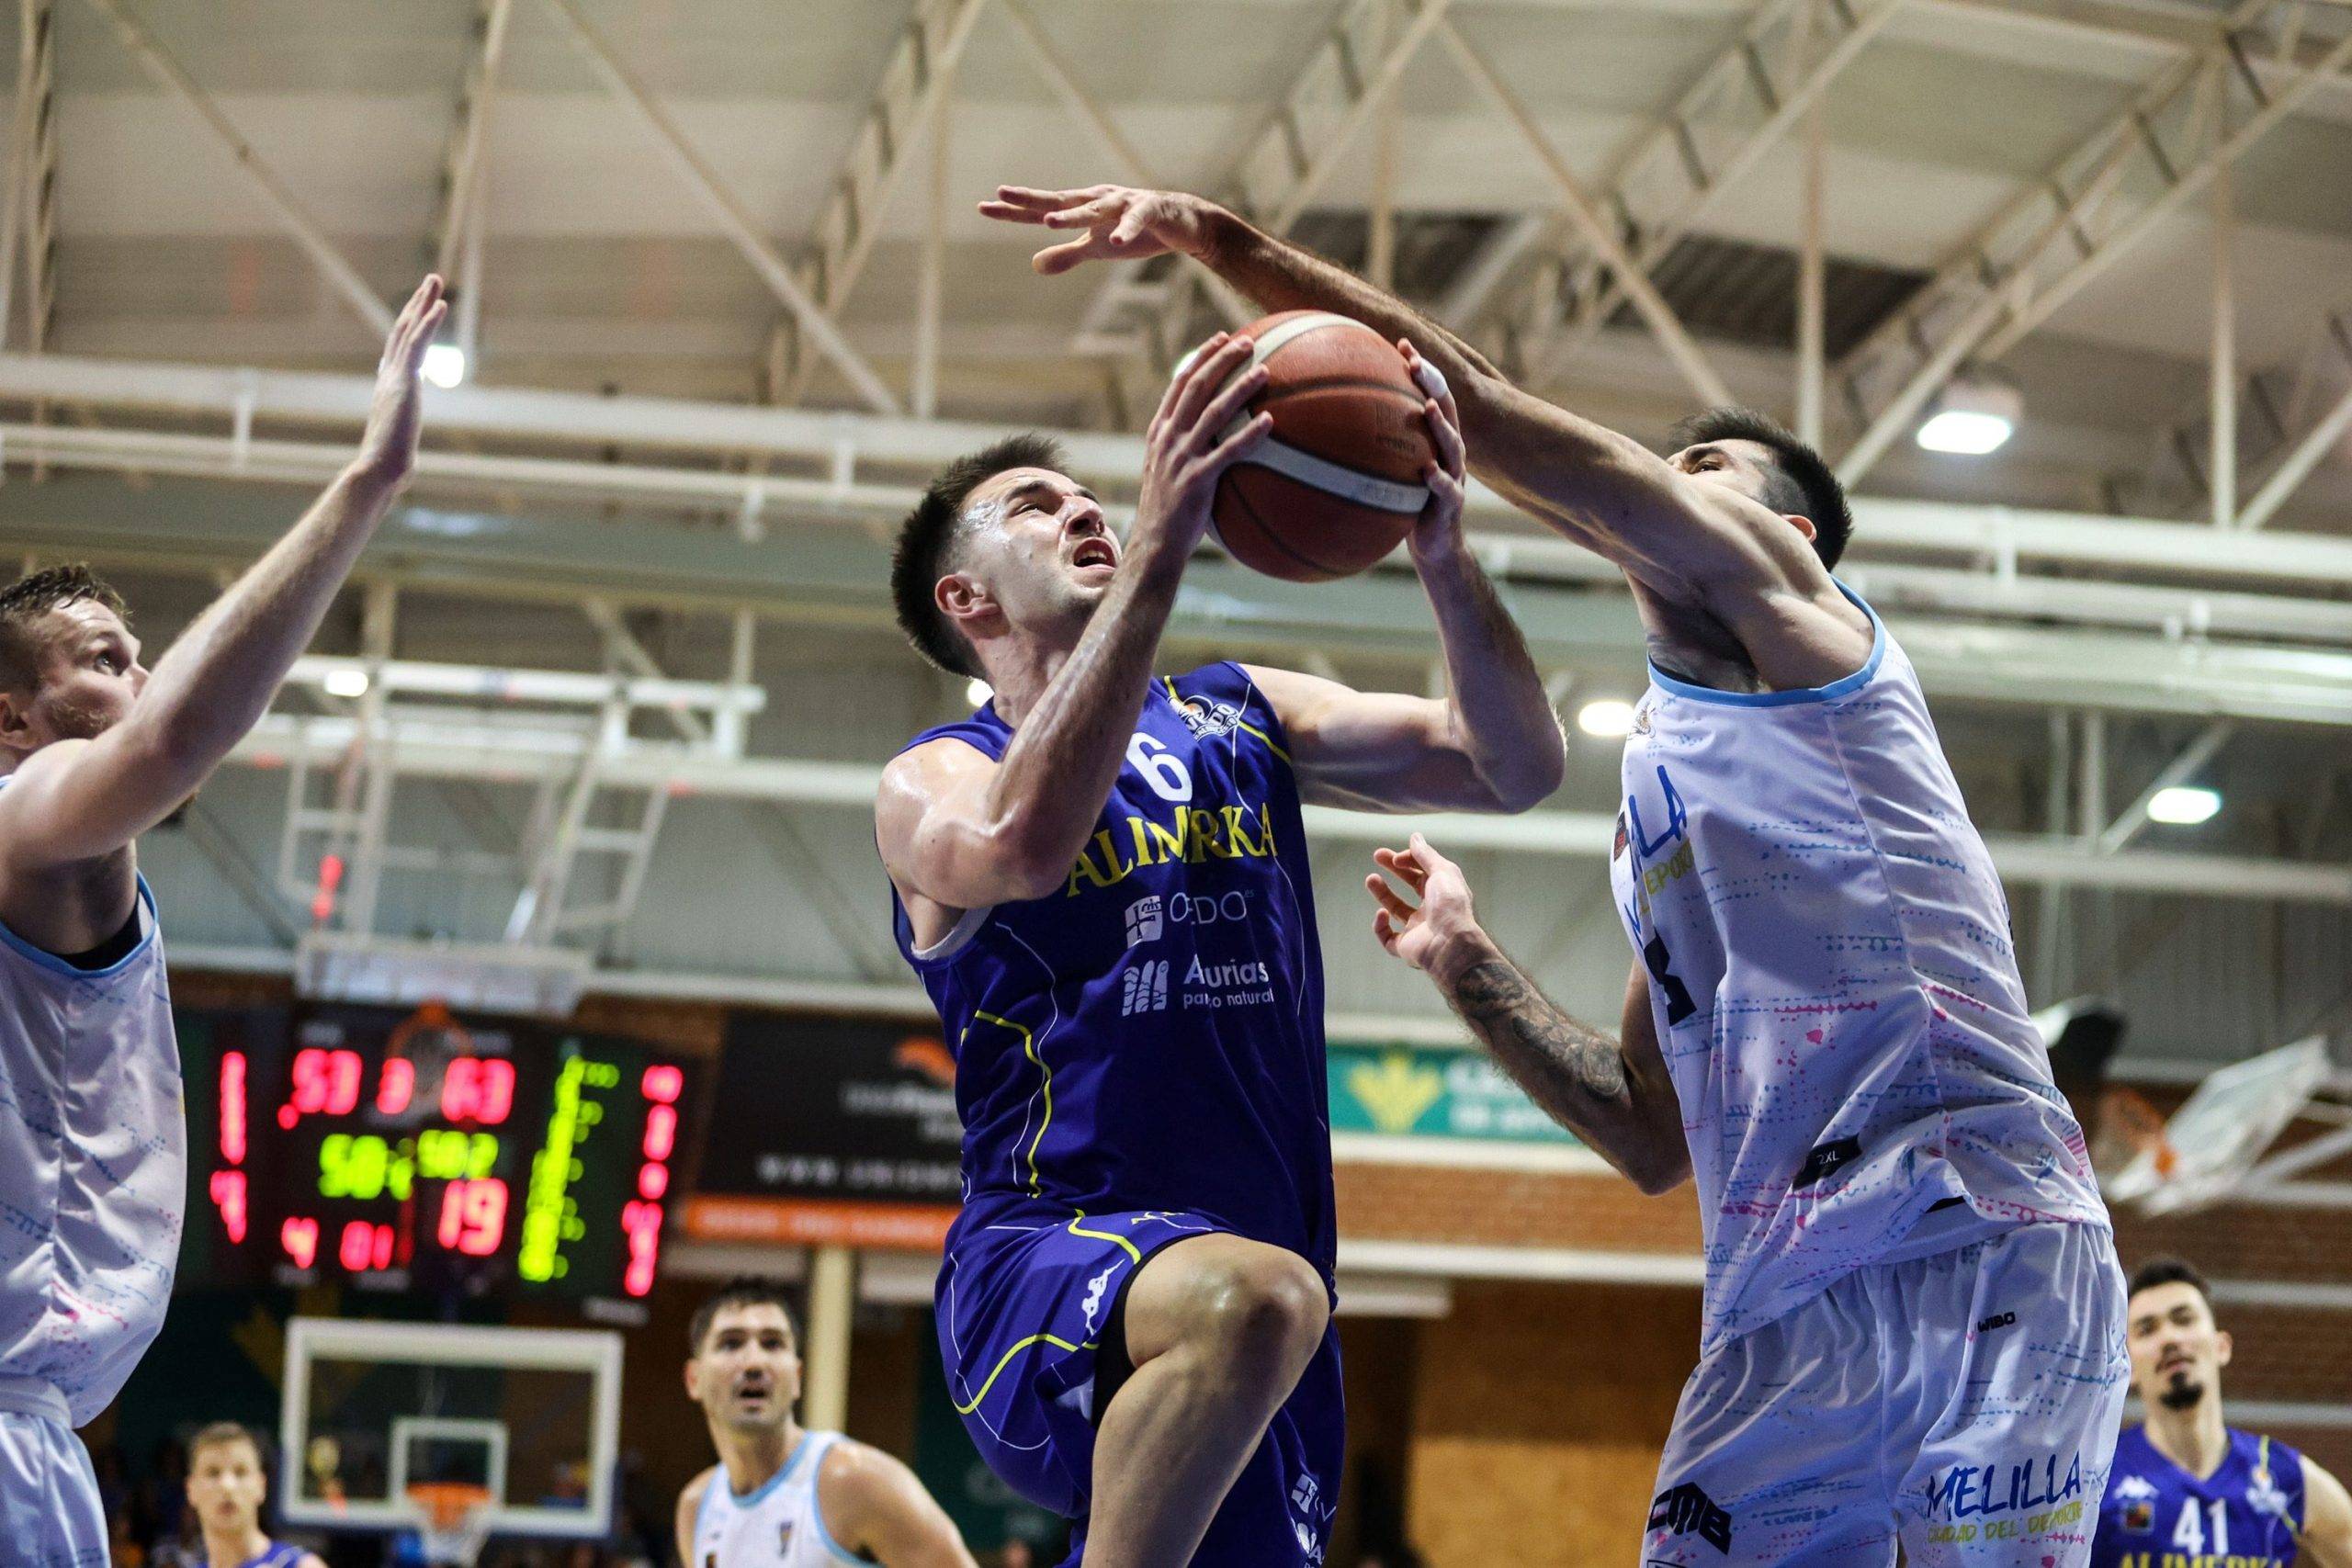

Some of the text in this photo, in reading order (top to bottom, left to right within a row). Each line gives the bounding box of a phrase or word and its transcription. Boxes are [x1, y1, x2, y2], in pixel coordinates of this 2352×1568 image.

[1125, 732, 1193, 802] 6
[1067, 802, 1278, 898] ALIMRKA
[1183, 953, 1270, 988] Aurias
[1227, 987, 1274, 1007] natural
[1816, 1150, 1839, 1166] 2XL
[438, 1178, 508, 1256] 19
[1977, 1311, 2016, 1332] WIBO
[1927, 1450, 2081, 1521] MELILLA
[1984, 1519, 2018, 1541] DEL
[2172, 1496, 2229, 1556] 41
